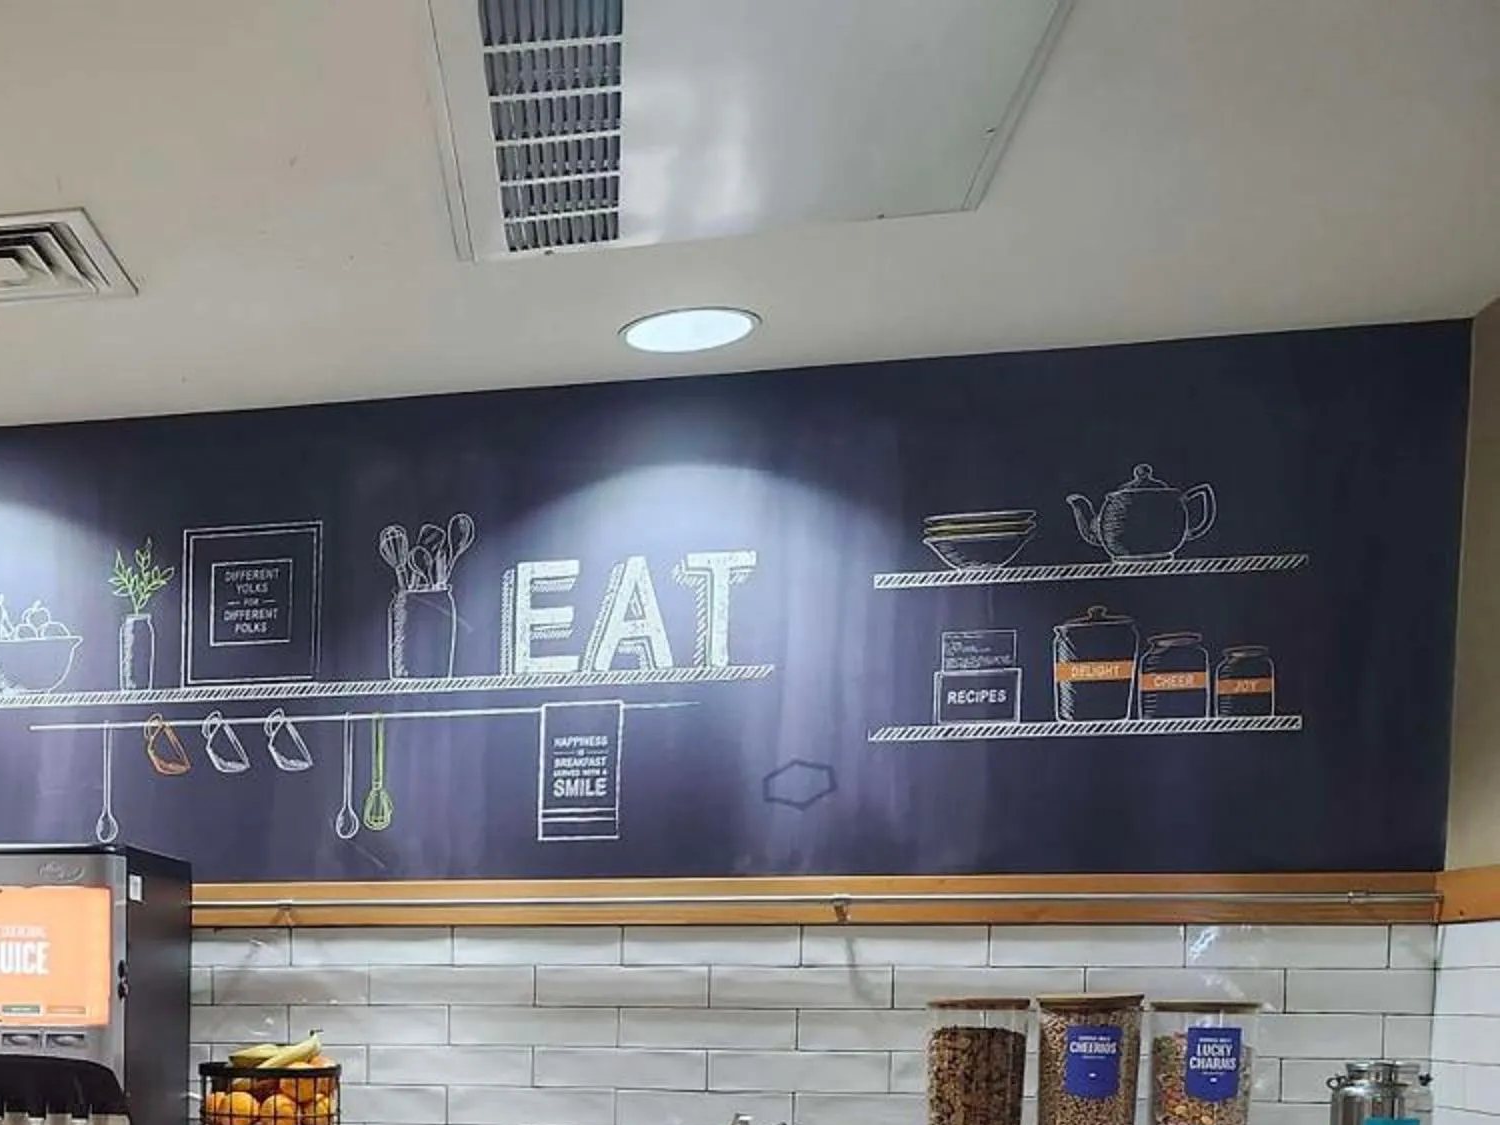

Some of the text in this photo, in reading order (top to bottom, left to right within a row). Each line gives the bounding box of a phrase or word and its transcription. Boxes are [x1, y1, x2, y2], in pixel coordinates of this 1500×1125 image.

[225, 568, 279, 581] DIFFERENT
[236, 582, 268, 594] YOLKS
[224, 608, 278, 621] DIFFERENT
[501, 551, 756, 676] EAT
[235, 622, 267, 633] FOLKS
[1071, 665, 1120, 677] DELIGHT
[1153, 675, 1194, 687] CHEER
[1235, 681, 1257, 691] JOY
[947, 689, 1007, 705] RECIPES
[553, 735, 607, 747] HAPPINESS
[553, 757, 607, 768] BREAKFAST
[553, 778, 607, 797] SMILE
[1197, 1043, 1233, 1057] LUCKY
[1190, 1056, 1236, 1070] CHARMS
